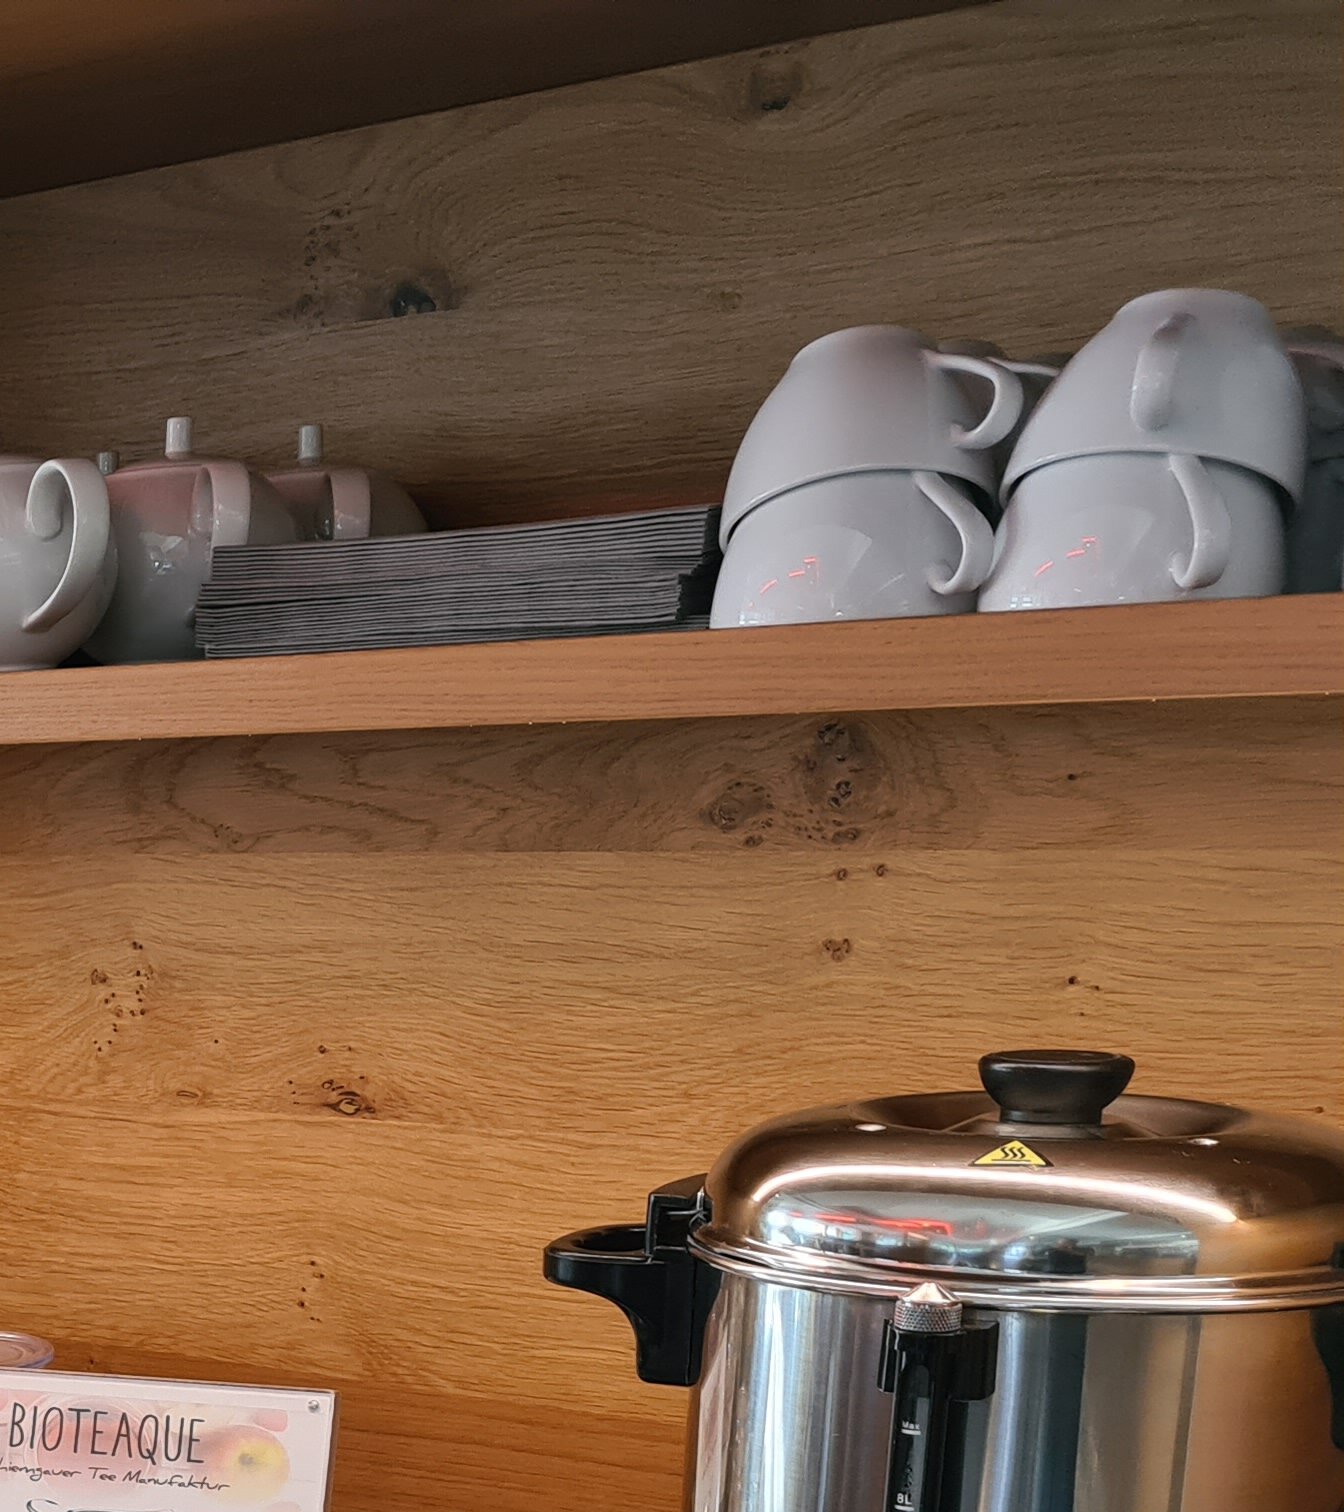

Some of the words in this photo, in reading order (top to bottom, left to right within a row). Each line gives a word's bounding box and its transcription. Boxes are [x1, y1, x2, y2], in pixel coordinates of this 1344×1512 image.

[8, 1402, 205, 1466] BIOTEAQUE
[88, 1467, 117, 1482] Tee
[122, 1471, 231, 1491] Manufaktur
[896, 1492, 912, 1505] 8L
